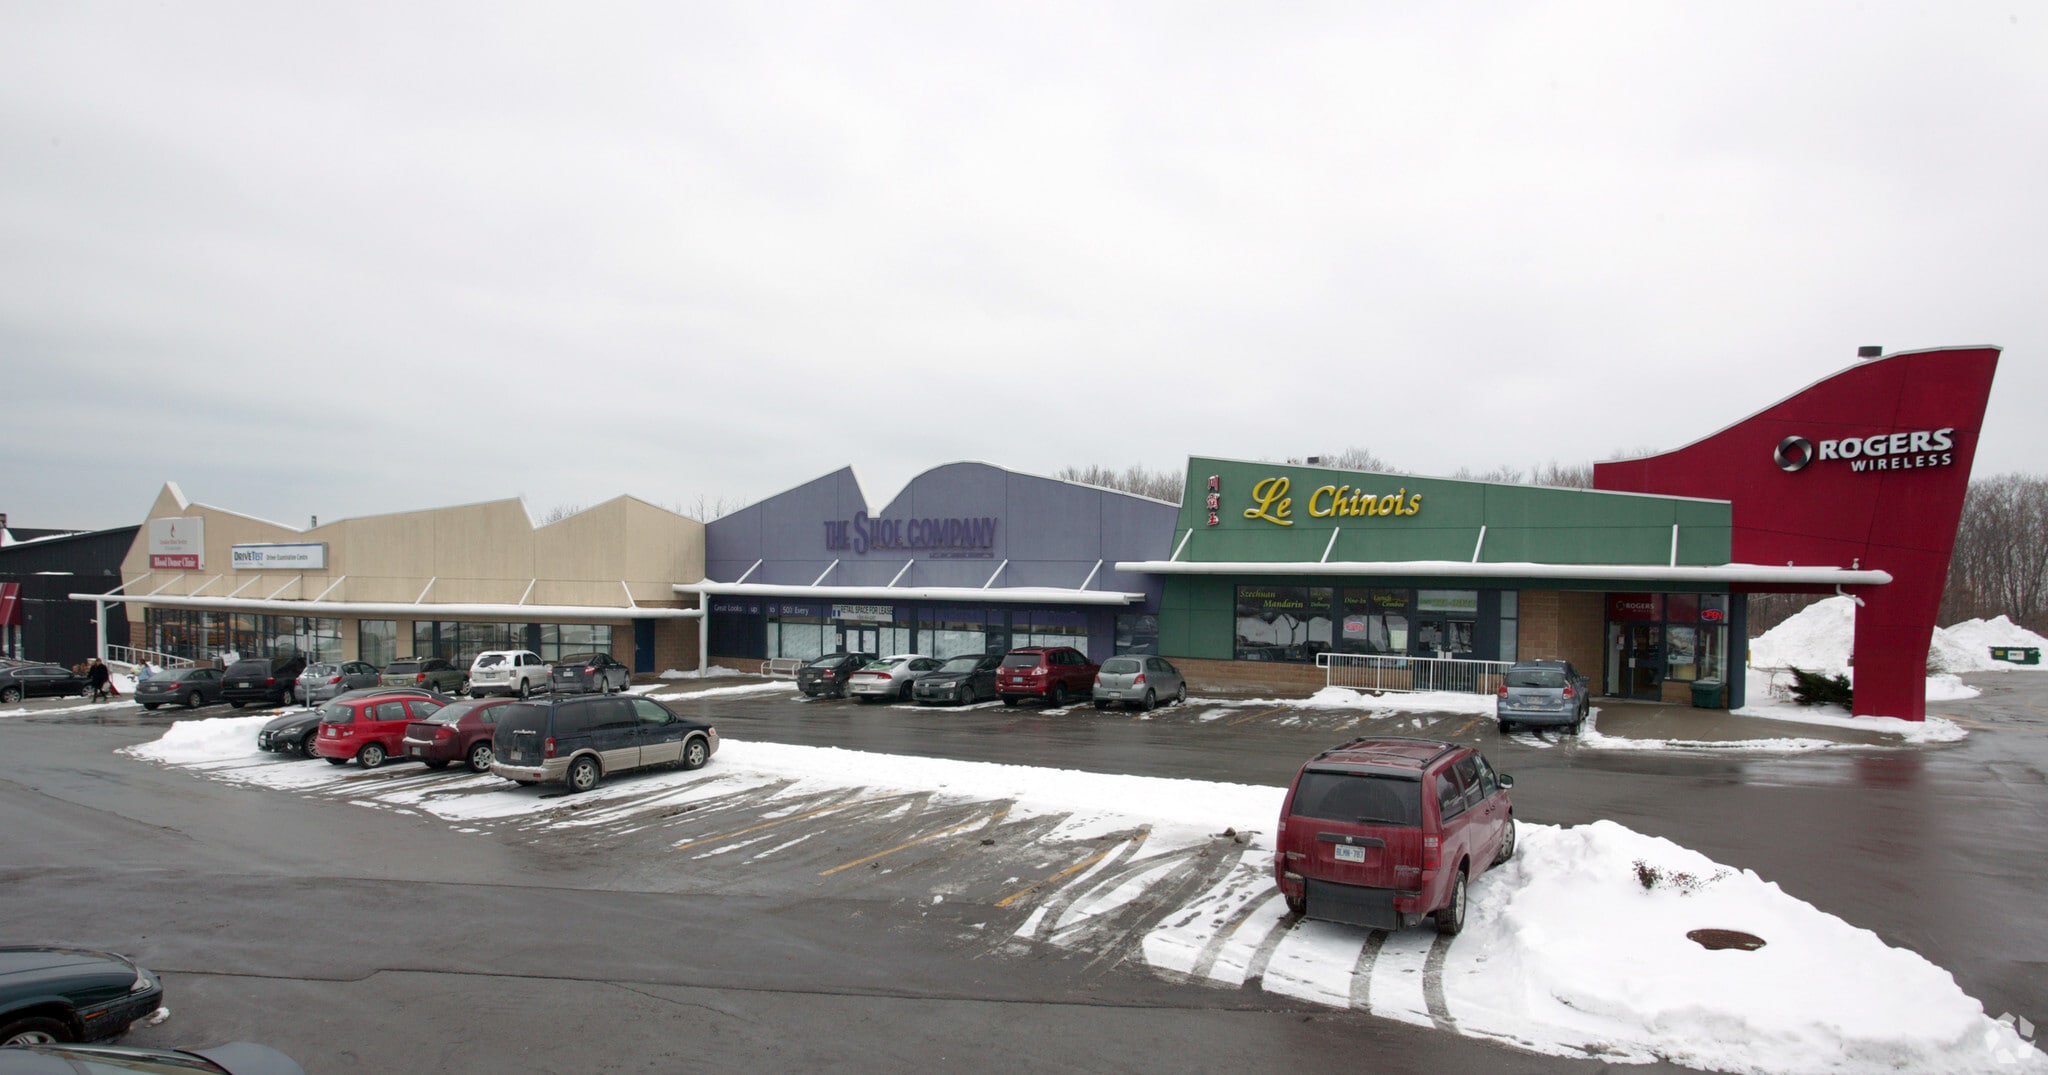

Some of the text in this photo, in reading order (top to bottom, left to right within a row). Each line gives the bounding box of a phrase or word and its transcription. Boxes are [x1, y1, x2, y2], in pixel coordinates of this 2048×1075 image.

[1819, 427, 1954, 461] ROGERS
[1851, 453, 1952, 472] WIRELESS
[1243, 477, 1422, 526] Le Chinois
[823, 510, 998, 555] THE SHOE COMPANY
[1240, 589, 1276, 598] Szechuan
[1263, 599, 1304, 608] Mandarin
[751, 606, 758, 614] up
[840, 605, 893, 615] RETAIL SPACE FOR LEASE
[1701, 609, 1723, 620] OPEN
